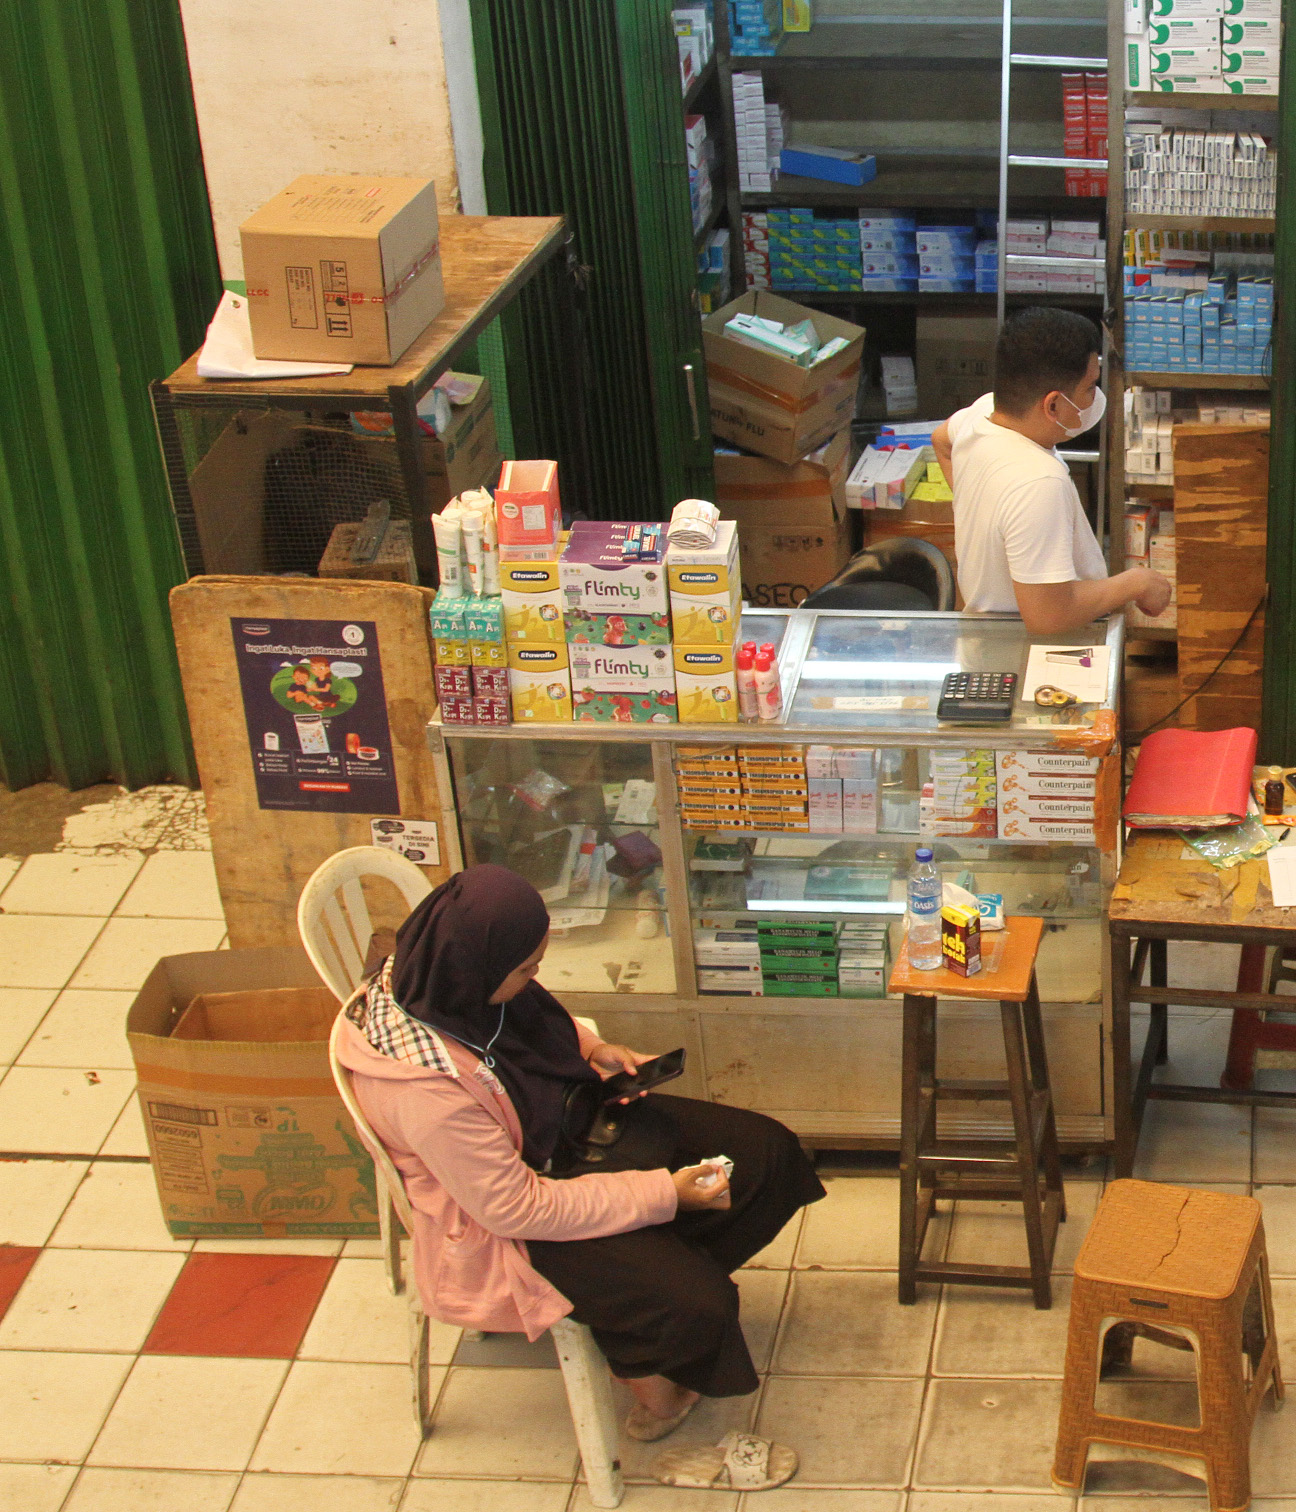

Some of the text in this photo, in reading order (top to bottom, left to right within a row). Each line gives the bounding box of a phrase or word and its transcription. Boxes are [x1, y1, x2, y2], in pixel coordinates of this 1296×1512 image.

[512, 572, 548, 580] Etawalin
[681, 574, 717, 582] Etawalin
[585, 581, 640, 600] flimty
[520, 651, 555, 660] Etawalin
[595, 659, 649, 678] flimty
[1037, 757, 1091, 767] Counterpain
[1038, 779, 1091, 790] Counterpain
[1038, 802, 1091, 813] Counterpain
[1039, 825, 1092, 835] Counterpain
[914, 902, 934, 910] OASIS
[942, 932, 966, 955] teh
